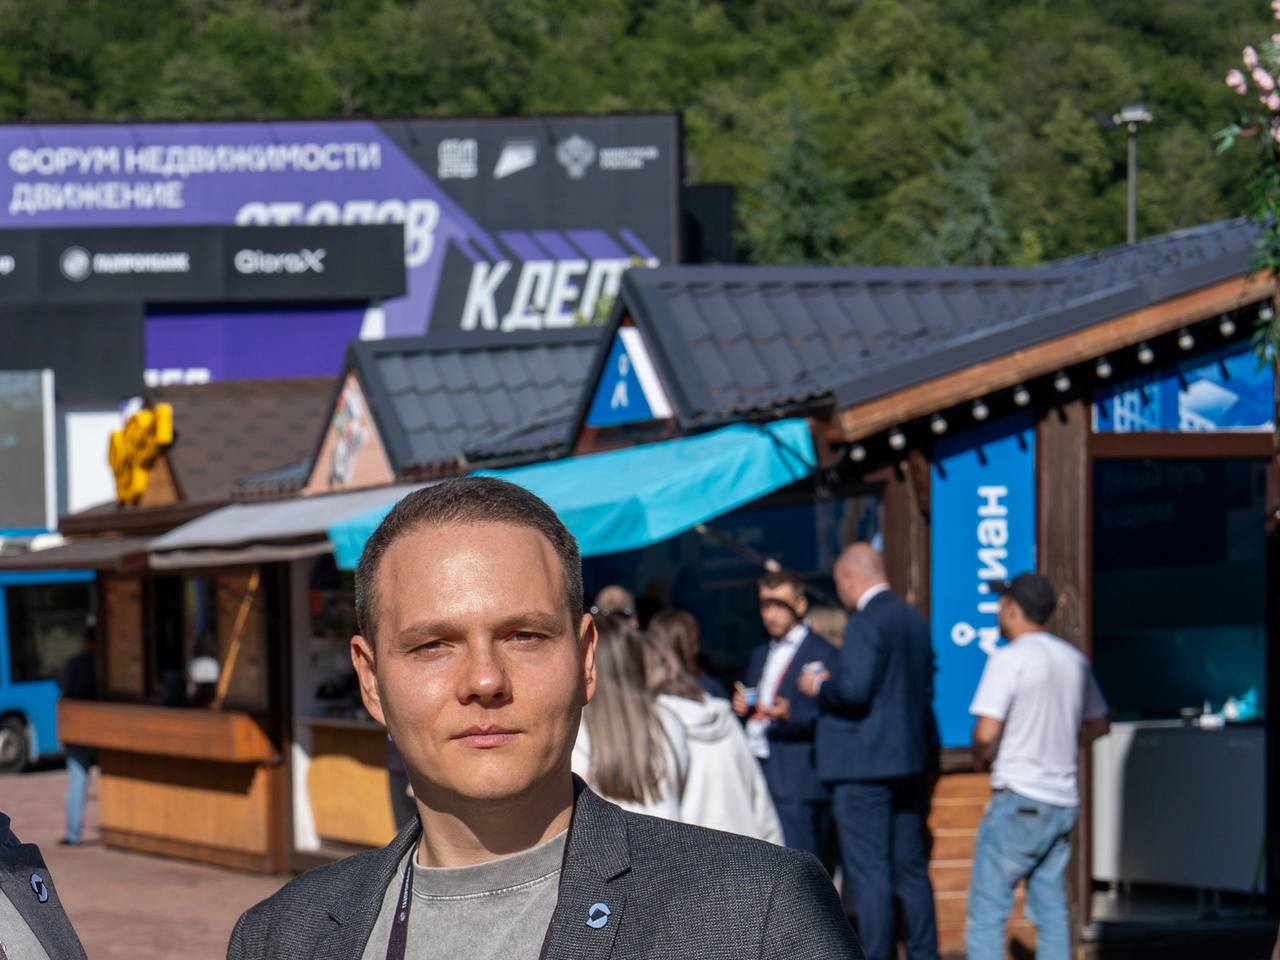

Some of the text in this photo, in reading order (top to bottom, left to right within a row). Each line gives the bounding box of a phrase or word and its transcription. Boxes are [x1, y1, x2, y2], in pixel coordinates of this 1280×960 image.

[8, 143, 381, 178] ФОРУМ НЕДВИЖИМОСТИ
[8, 181, 185, 216] ДВИЖЕНИЕ
[460, 256, 661, 332] К ДЕЛ
